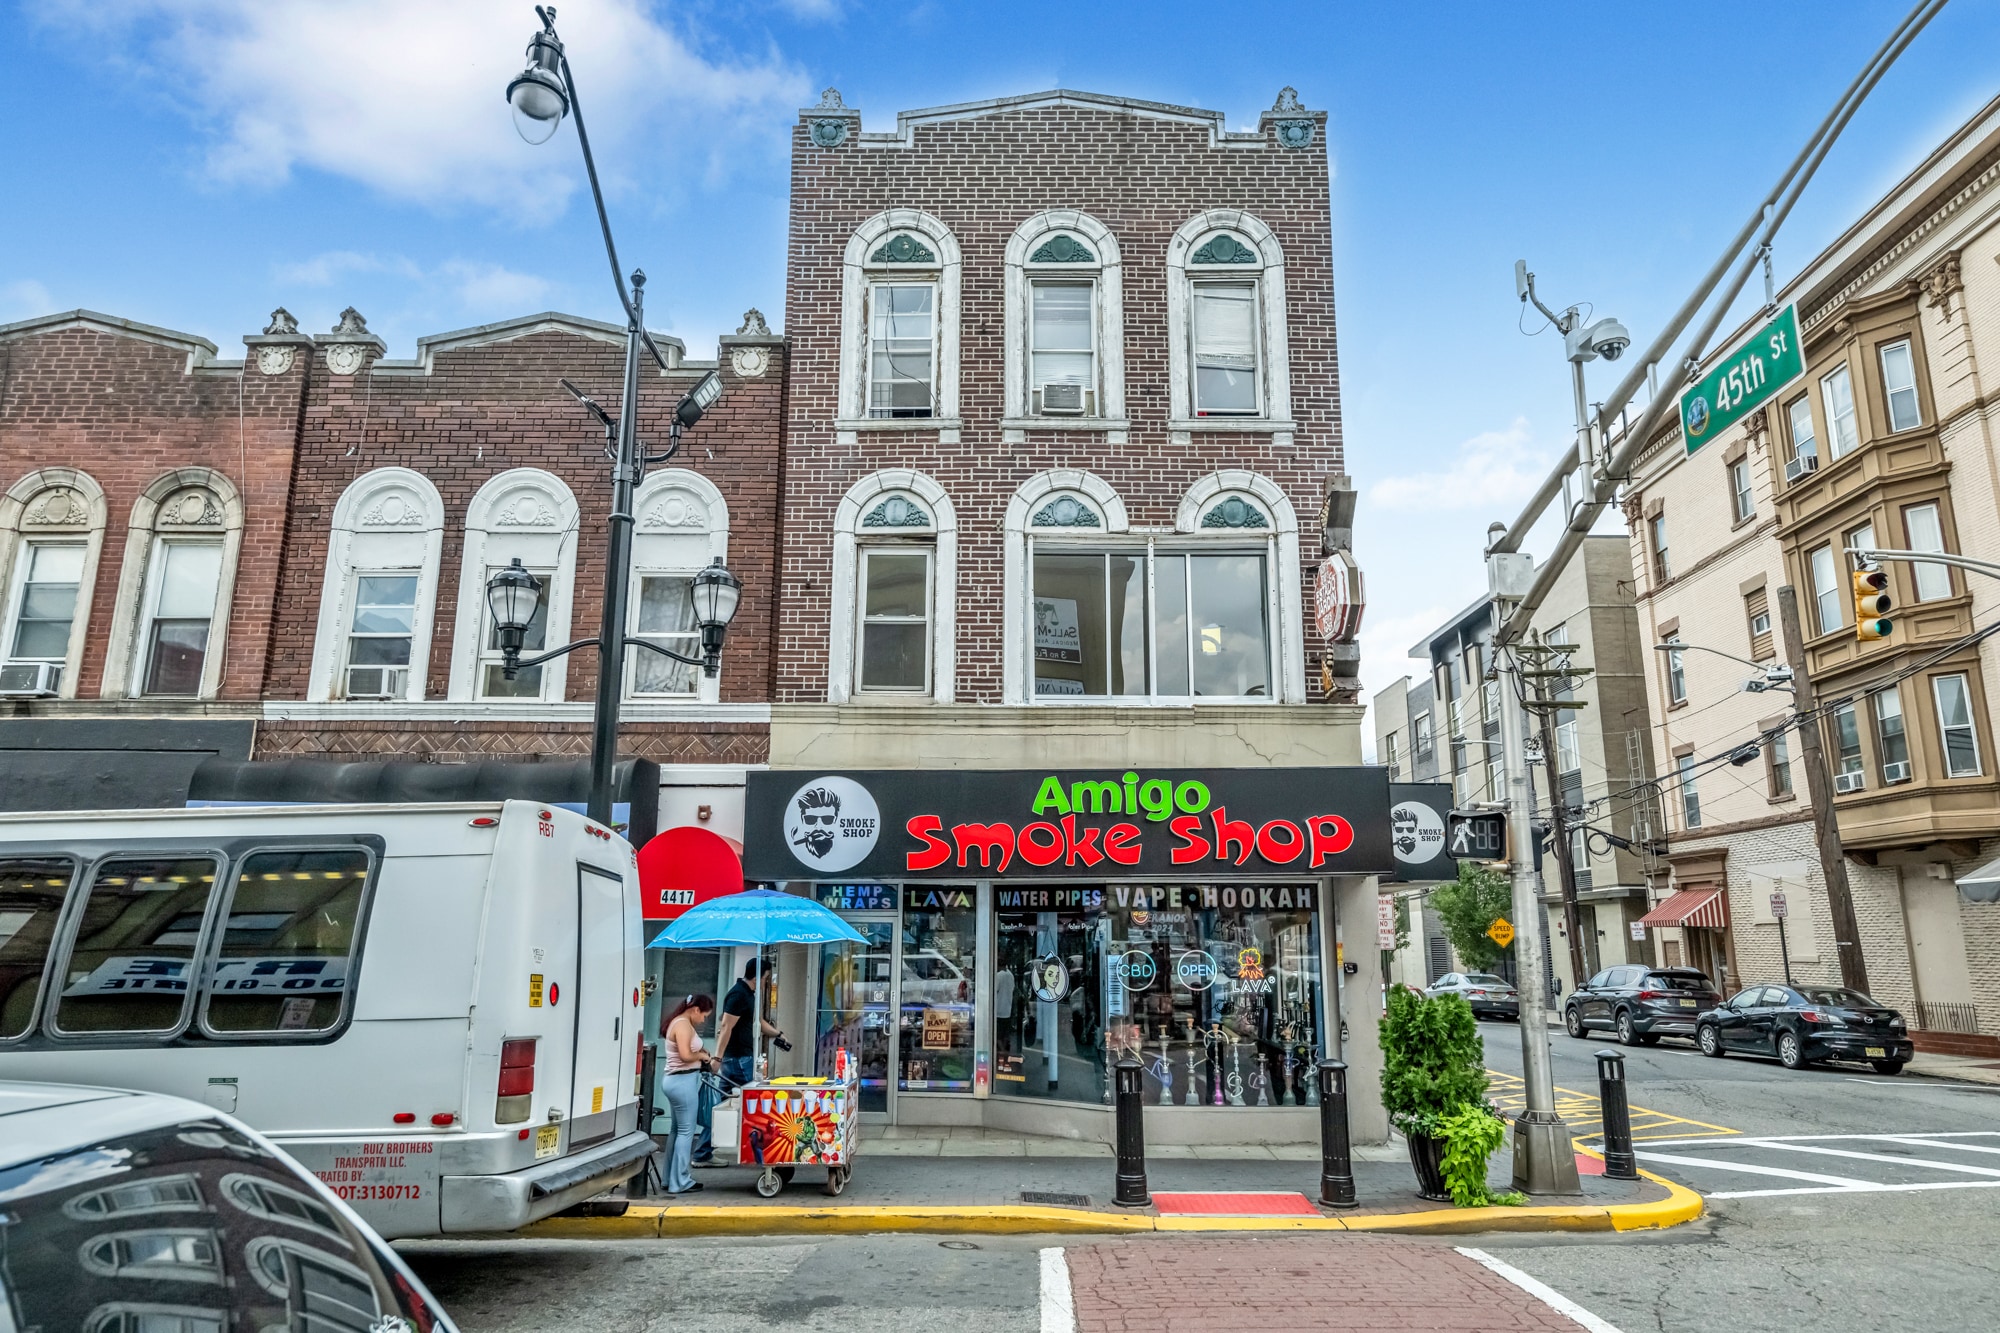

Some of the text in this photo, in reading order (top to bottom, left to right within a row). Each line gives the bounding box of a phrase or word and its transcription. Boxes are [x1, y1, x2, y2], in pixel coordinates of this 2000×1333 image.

[1716, 330, 1787, 411] 45th St
[1032, 771, 1211, 822] Amigo
[539, 822, 554, 838] RB7
[839, 818, 876, 829] SMOKE
[842, 828, 873, 838] SHOP
[906, 806, 1355, 873] Smoke Shop
[661, 890, 693, 904] 4417
[832, 886, 883, 896] HEMP
[1115, 887, 1312, 908] VAPE HOOKAH
[826, 898, 891, 909] WRAPS
[910, 891, 971, 908] LAVA
[1000, 891, 1101, 907] WATER PIPES
[787, 932, 824, 941] NAUTICA
[1120, 964, 1152, 977] CBD
[1180, 965, 1214, 977] OPEN
[927, 1019, 948, 1027] RAW
[928, 1031, 946, 1041] OPEN
[363, 1142, 433, 1155] RUIZ BROTHERS
[335, 1156, 407, 1169] TRANSPRTN LLC.
